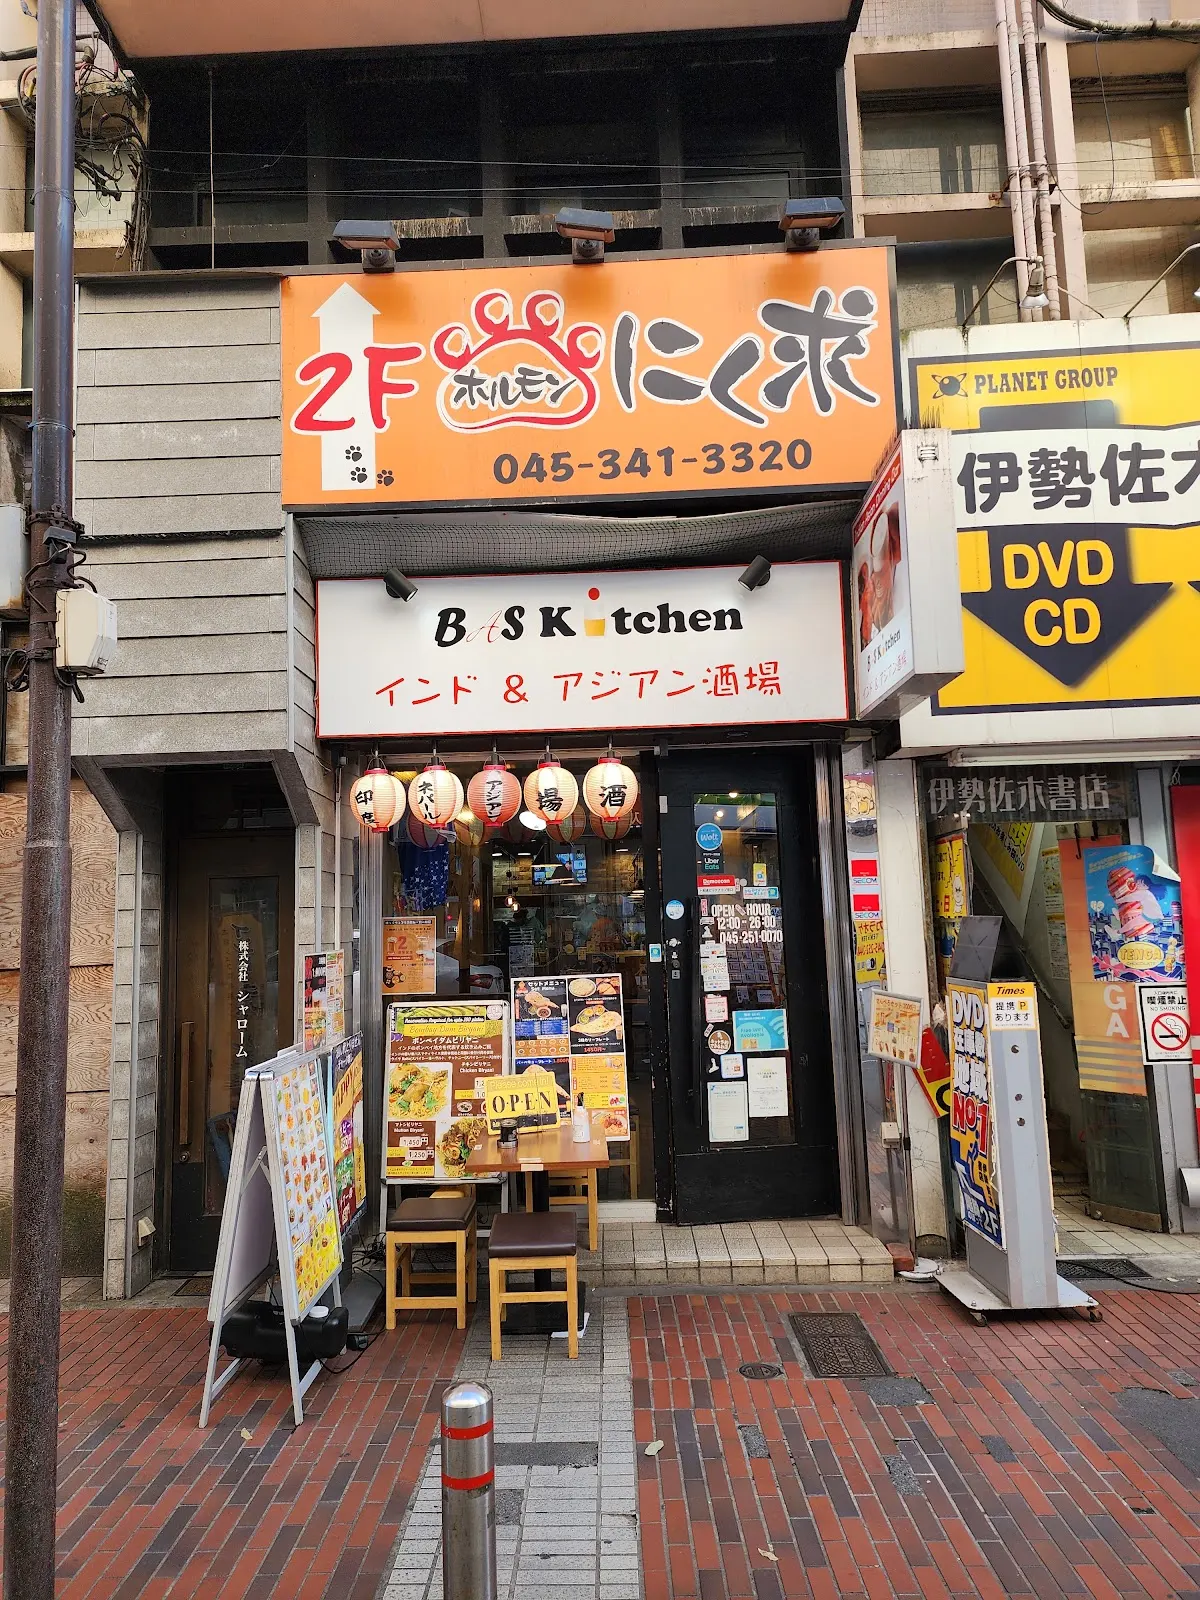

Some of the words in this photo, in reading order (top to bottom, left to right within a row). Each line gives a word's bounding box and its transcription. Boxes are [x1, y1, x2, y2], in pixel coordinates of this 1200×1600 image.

[293, 345, 423, 432] 2F
[450, 363, 582, 410] ホルモン
[974, 370, 1049, 395] PLANET
[1055, 366, 1119, 391] GROUP
[493, 438, 813, 485] 045-341-3320
[1001, 540, 1115, 590] DVD
[1023, 597, 1101, 647] CD
[375, 674, 478, 709] インド
[503, 676, 529, 704] &
[554, 660, 782, 702] アジアン酒場
[417, 780, 442, 820] ネパール
[485, 779, 503, 819] アジアン
[536, 787, 564, 812] 場
[599, 784, 628, 808] 酒
[928, 773, 1110, 814] 伊勢佐木書店
[700, 833, 718, 842] Wolt
[711, 904, 735, 917] OPEN
[745, 903, 771, 916] HOUR
[717, 917, 741, 930] 12:00
[749, 915, 776, 929] 26:00
[720, 930, 784, 944] 045-251-0070
[1121, 948, 1163, 961] TENGA
[238, 940, 249, 982] 株式会社
[997, 986, 1025, 995] Times
[1147, 995, 1187, 1005] 喫煙禁止
[236, 990, 250, 1058] シャローム
[952, 989, 984, 1029] DVD
[995, 1013, 1030, 1022] あります
[979, 1204, 999, 1237] 2F
